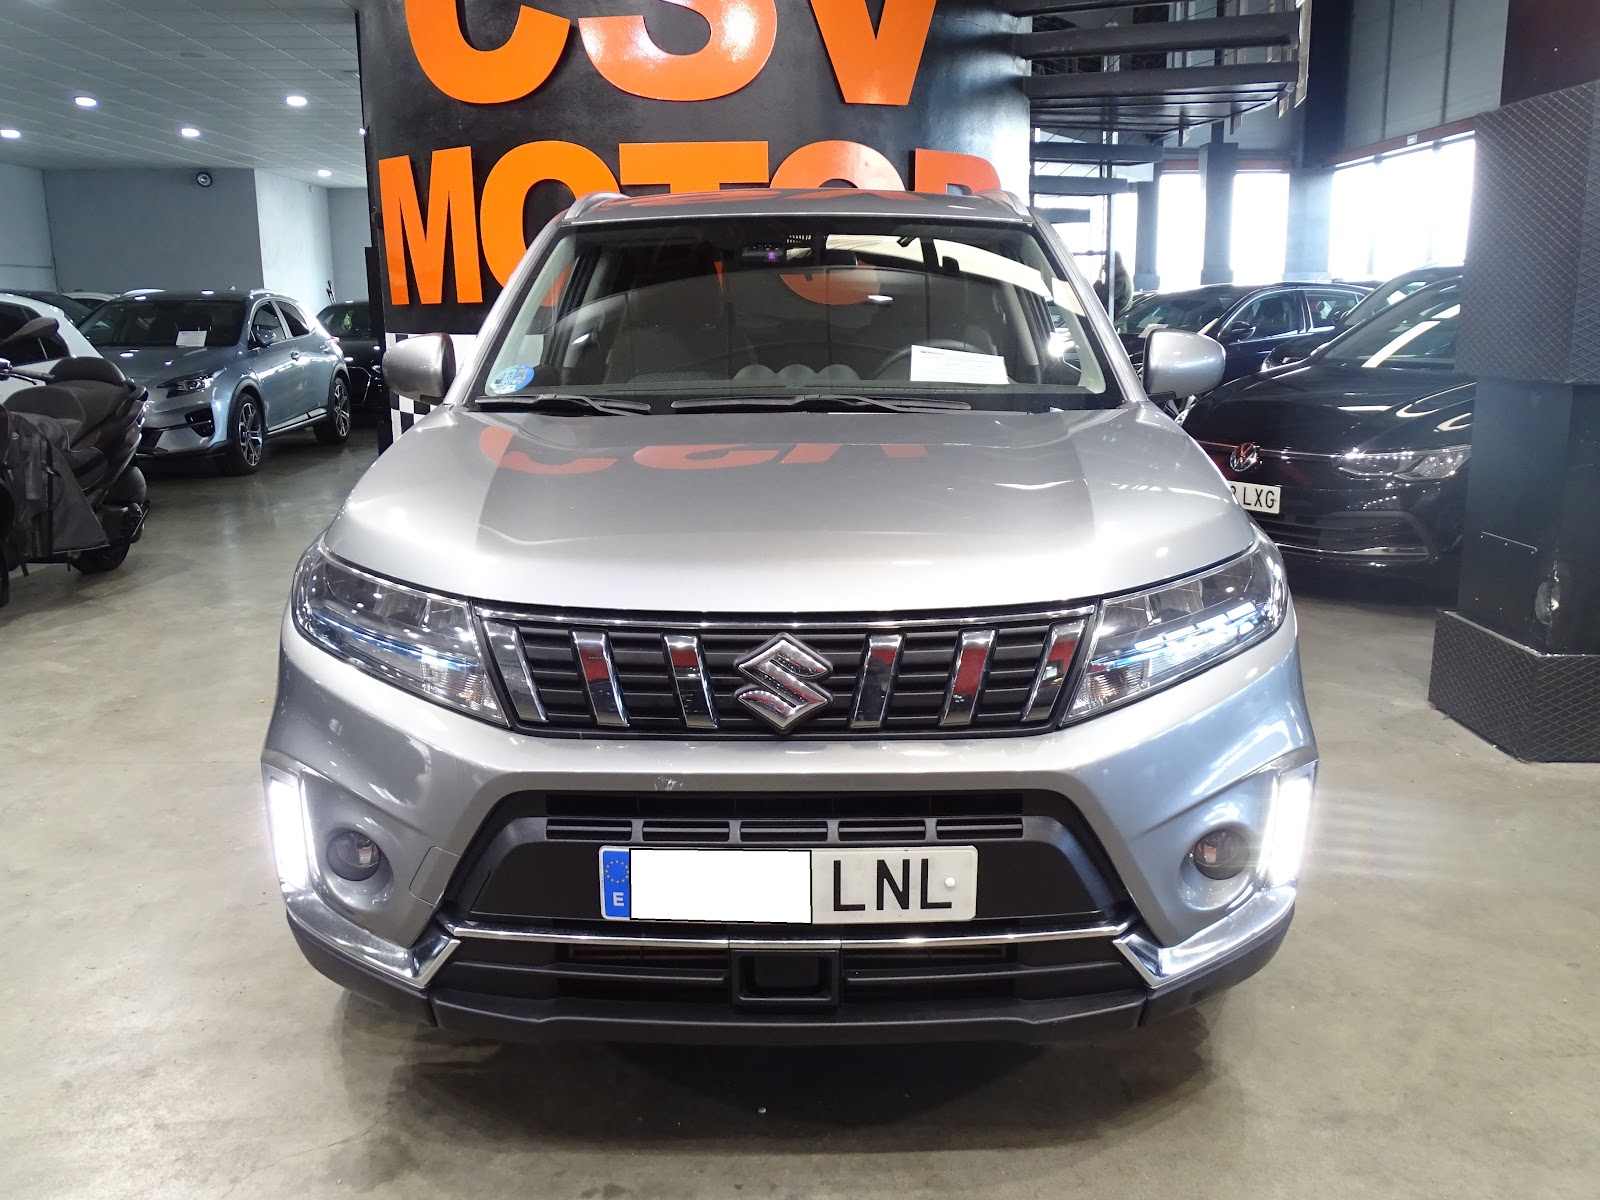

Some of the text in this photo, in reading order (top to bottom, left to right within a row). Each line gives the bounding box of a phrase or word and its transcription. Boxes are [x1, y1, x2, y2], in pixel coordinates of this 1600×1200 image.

[378, 140, 1002, 306] MOT
[1242, 486, 1276, 509] LXG
[612, 891, 625, 907] E
[833, 858, 952, 912] LNL
